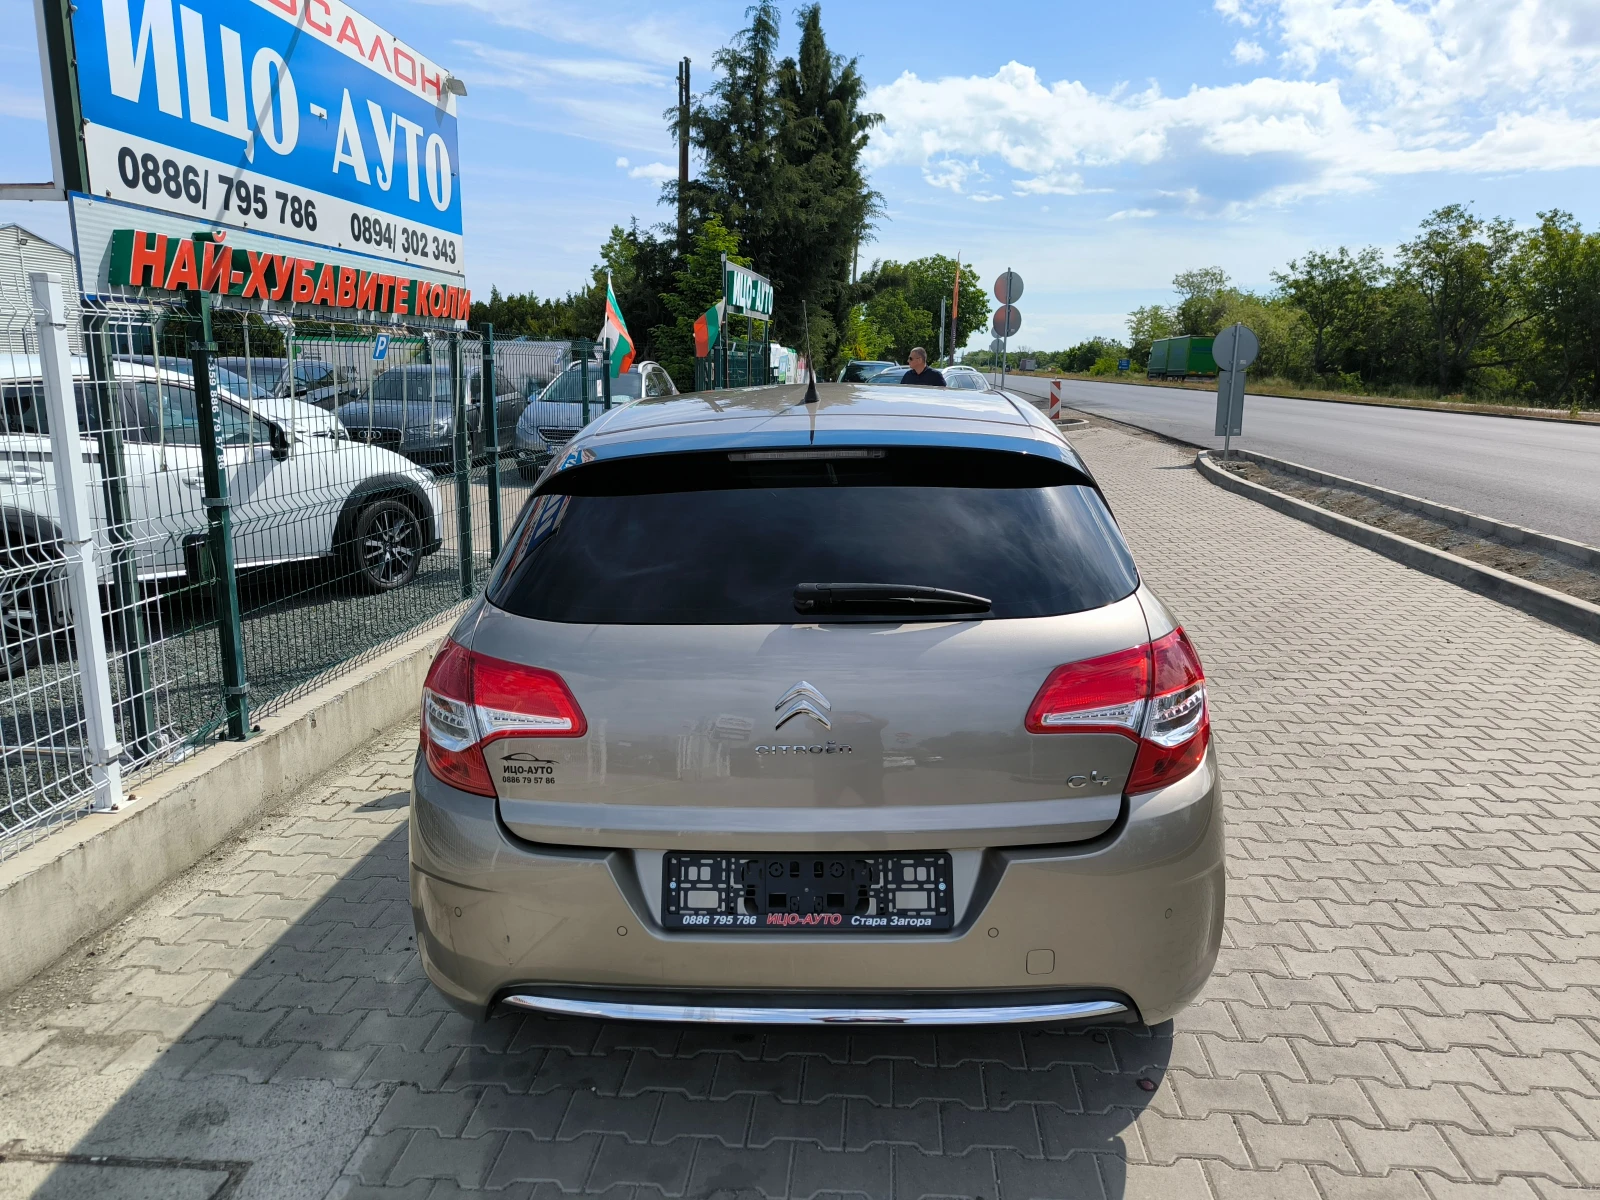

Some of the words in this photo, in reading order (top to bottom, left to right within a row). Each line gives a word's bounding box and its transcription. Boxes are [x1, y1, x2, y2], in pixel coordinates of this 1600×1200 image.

[218, 174, 268, 220] 795
[275, 190, 318, 232] 786
[401, 227, 428, 258] 302
[432, 236, 456, 265] 343
[129, 229, 410, 316] НАЙ-ХУБАВИТЕ
[415, 280, 471, 321] КОЛИ
[733, 270, 774, 316] ИЦО-АУТО
[207, 354, 217, 387] +359
[210, 389, 219, 413] 886
[213, 416, 221, 432] 79
[215, 436, 224, 451] 57
[217, 454, 226, 470] 86
[503, 765, 553, 775] ИЦО-АУТО
[502, 776, 521, 784] 0886
[522, 776, 532, 784] 79
[545, 777, 556, 785] 86
[682, 915, 710, 925] 0886
[713, 915, 734, 925] 795
[736, 915, 757, 925] 786
[766, 912, 842, 926] ИЦО-АУТО
[851, 915, 887, 927] Стара
[890, 916, 932, 927] Загора
